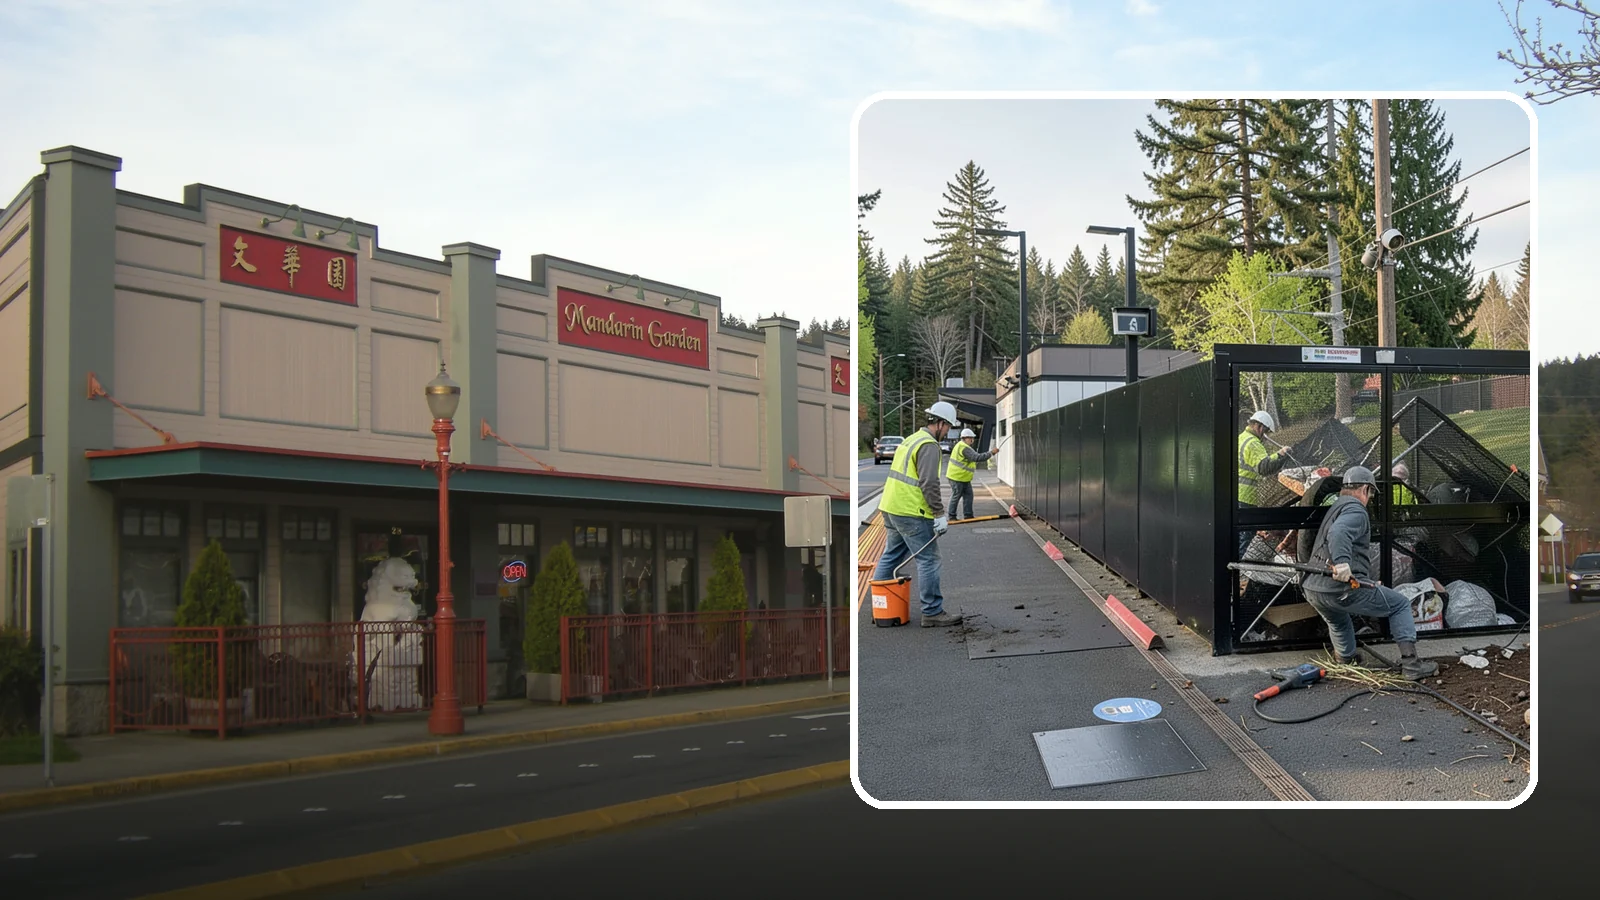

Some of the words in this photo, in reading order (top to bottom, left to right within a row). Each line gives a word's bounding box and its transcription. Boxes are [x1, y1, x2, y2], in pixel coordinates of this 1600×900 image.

[231, 236, 346, 291] 文華園
[565, 302, 644, 341] Mandarin
[647, 320, 701, 352] Garden
[503, 565, 527, 578] OPEN
